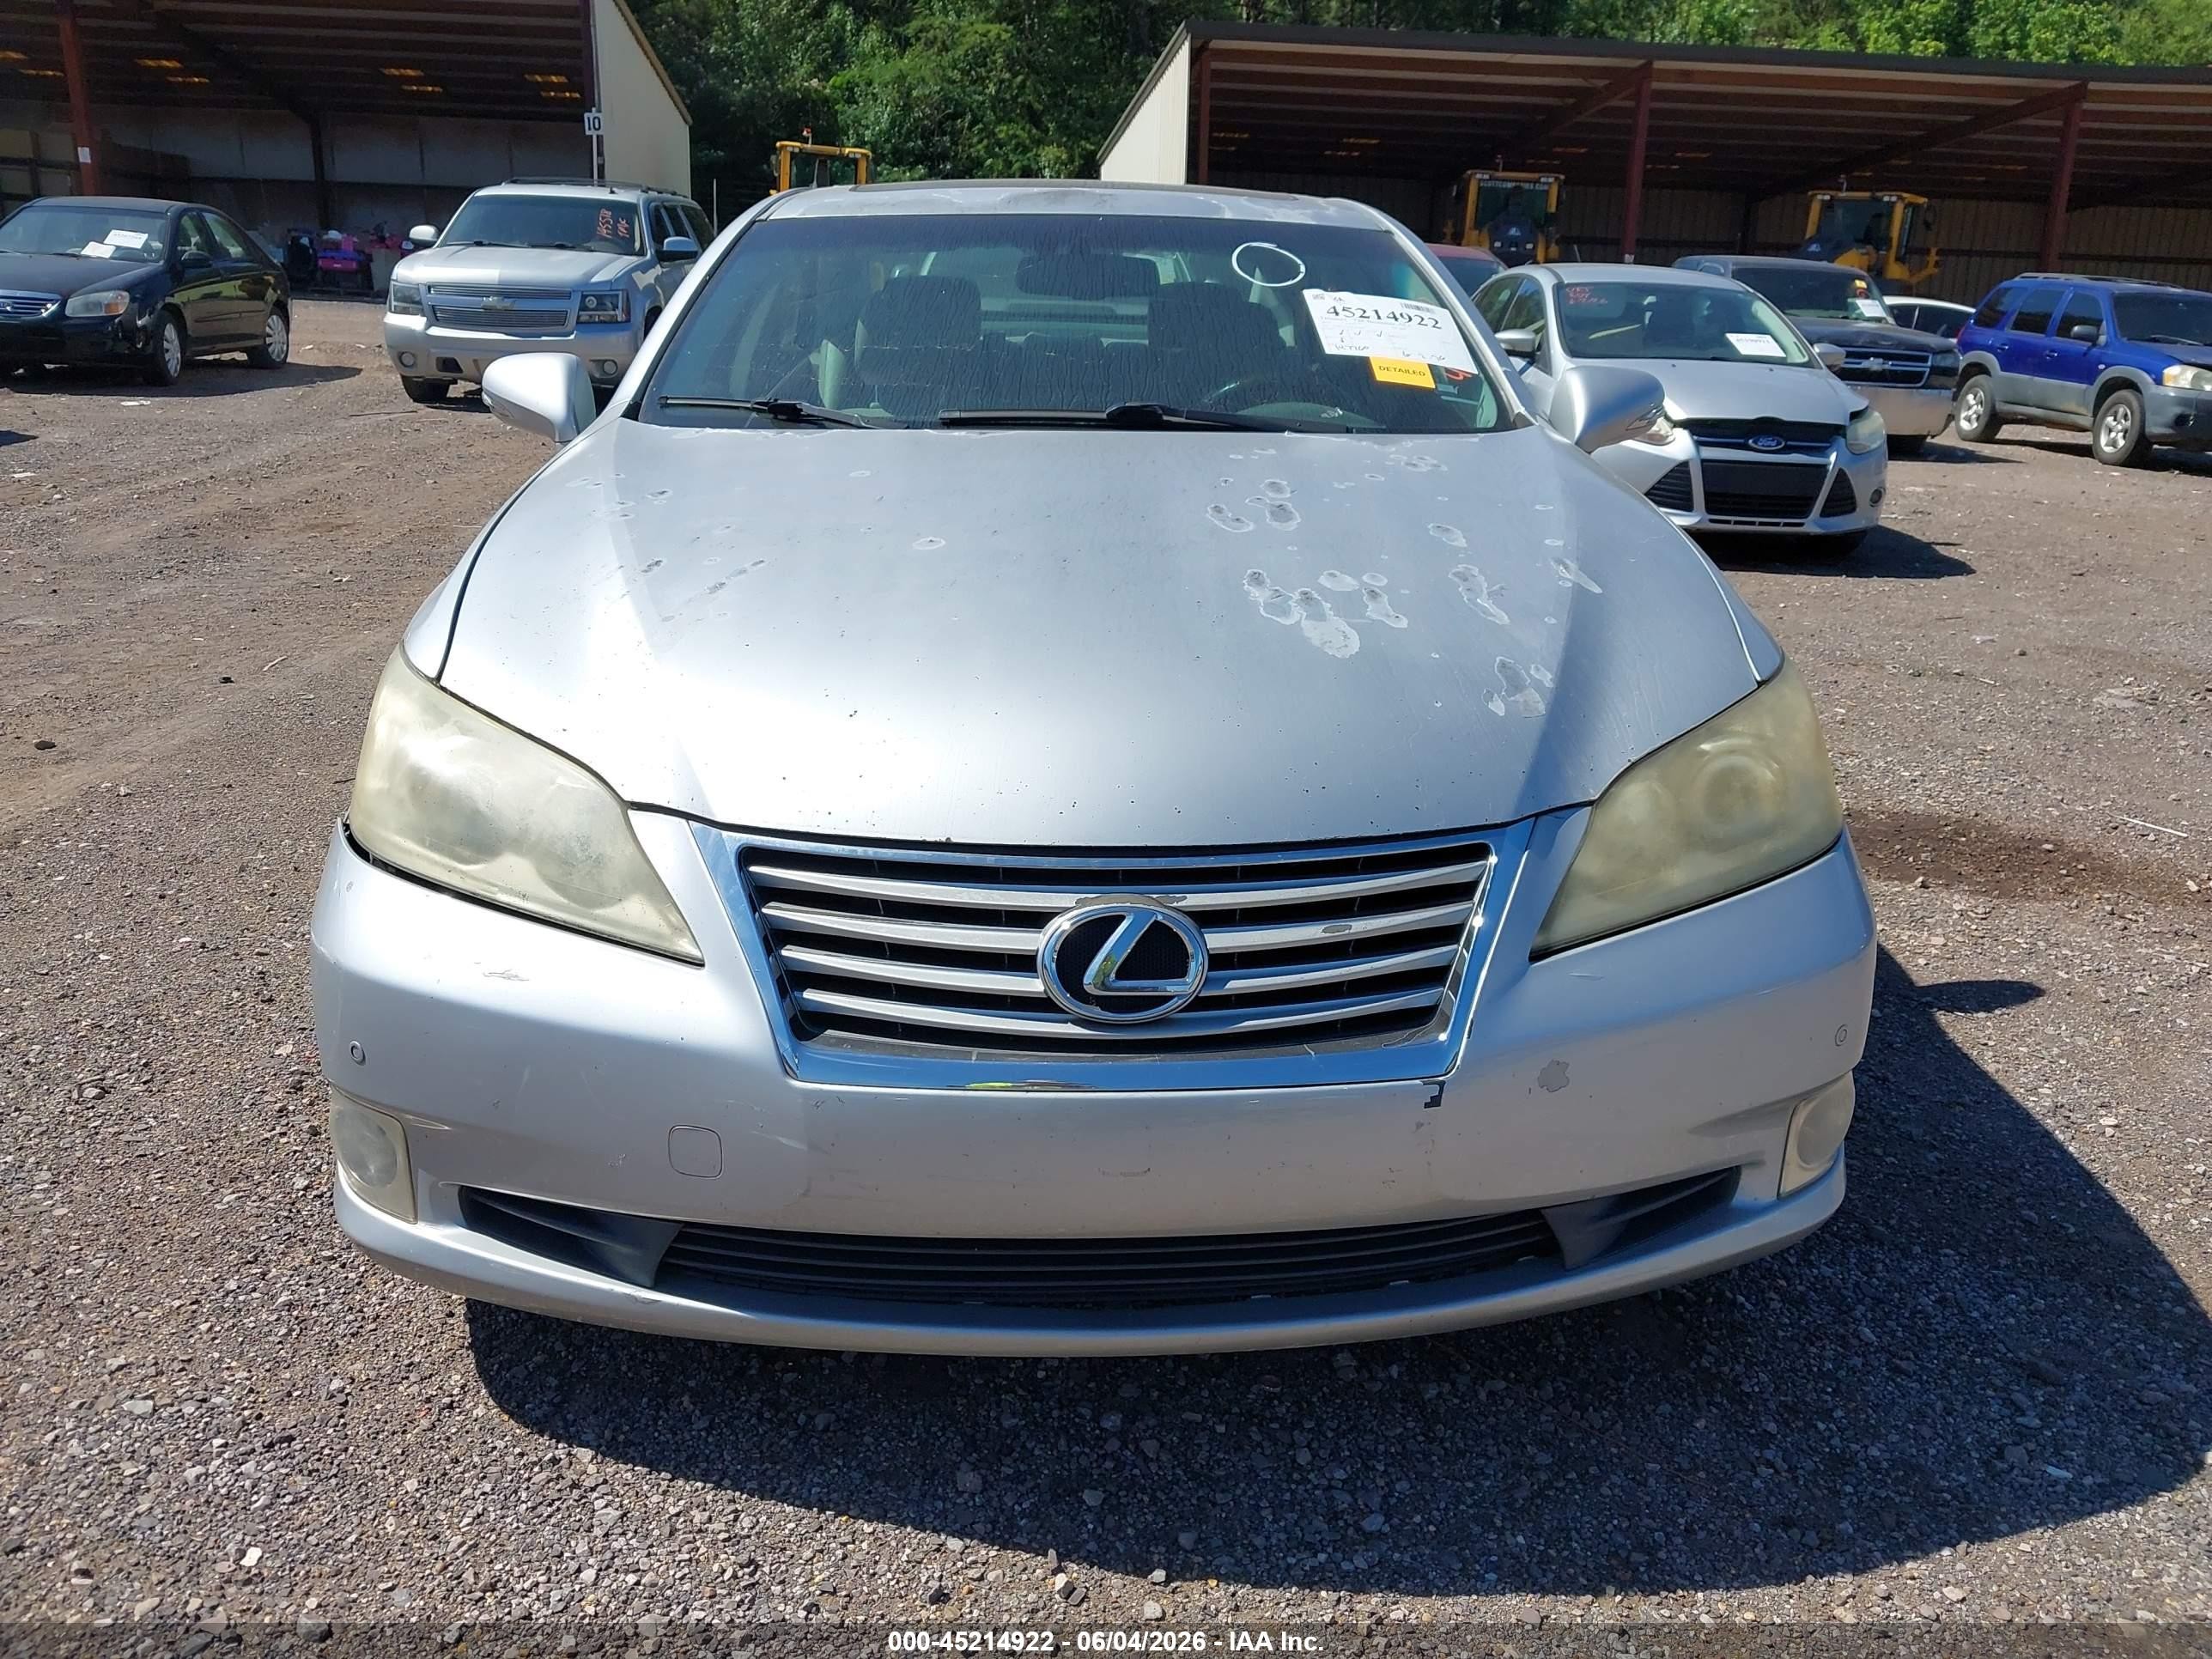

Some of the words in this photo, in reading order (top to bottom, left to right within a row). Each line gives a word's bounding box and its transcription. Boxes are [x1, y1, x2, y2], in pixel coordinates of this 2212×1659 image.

[586, 116, 602, 131] 10
[1327, 304, 1443, 330] 45214922
[1378, 365, 1426, 377] DETAILED
